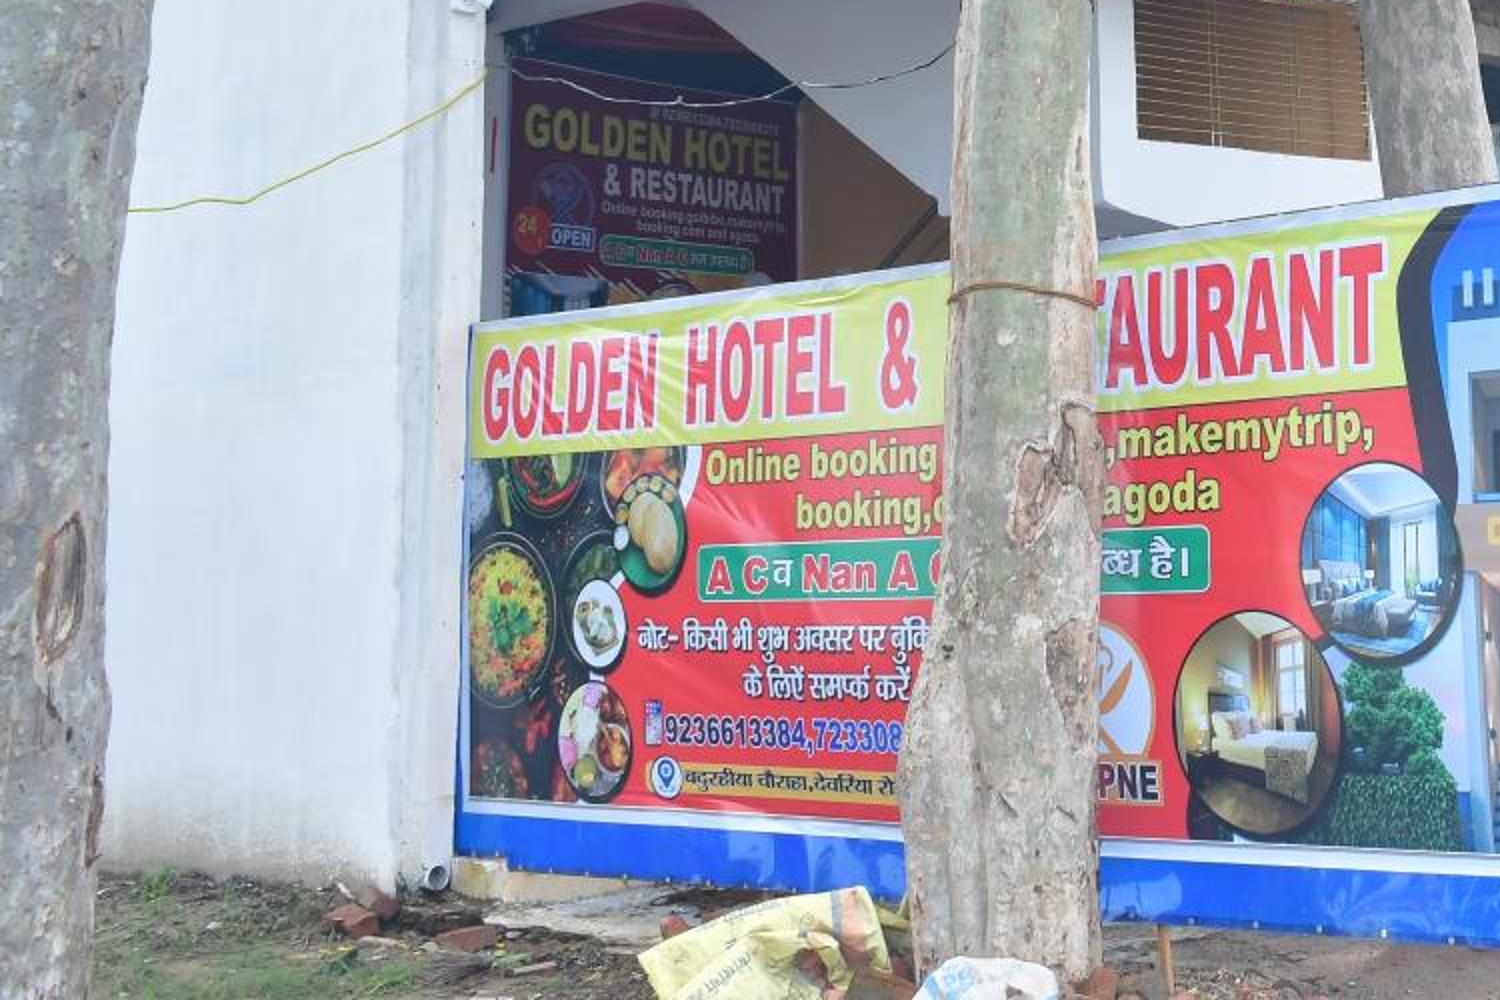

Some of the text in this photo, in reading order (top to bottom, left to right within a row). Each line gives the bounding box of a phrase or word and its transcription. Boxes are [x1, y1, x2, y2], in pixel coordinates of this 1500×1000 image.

[523, 102, 673, 165] GOLDEN
[683, 128, 789, 182] HOTEL
[603, 166, 785, 216] & RESTAURANT
[551, 228, 592, 248] OPEN
[483, 331, 658, 442] GOLDEN
[685, 311, 848, 427] HOTEL
[880, 300, 918, 410] &
[706, 447, 801, 486] Online
[810, 436, 938, 483] booking
[1102, 470, 1222, 525] agoda
[801, 553, 877, 594] Nan
[683, 617, 729, 653] किसी
[731, 618, 754, 653] भी
[756, 623, 790, 665] शुभ
[793, 624, 854, 653] अवसर
[858, 624, 886, 653] पर
[742, 664, 763, 698] के
[874, 665, 912, 702] करें
[665, 714, 903, 756] 9236613384,723308
